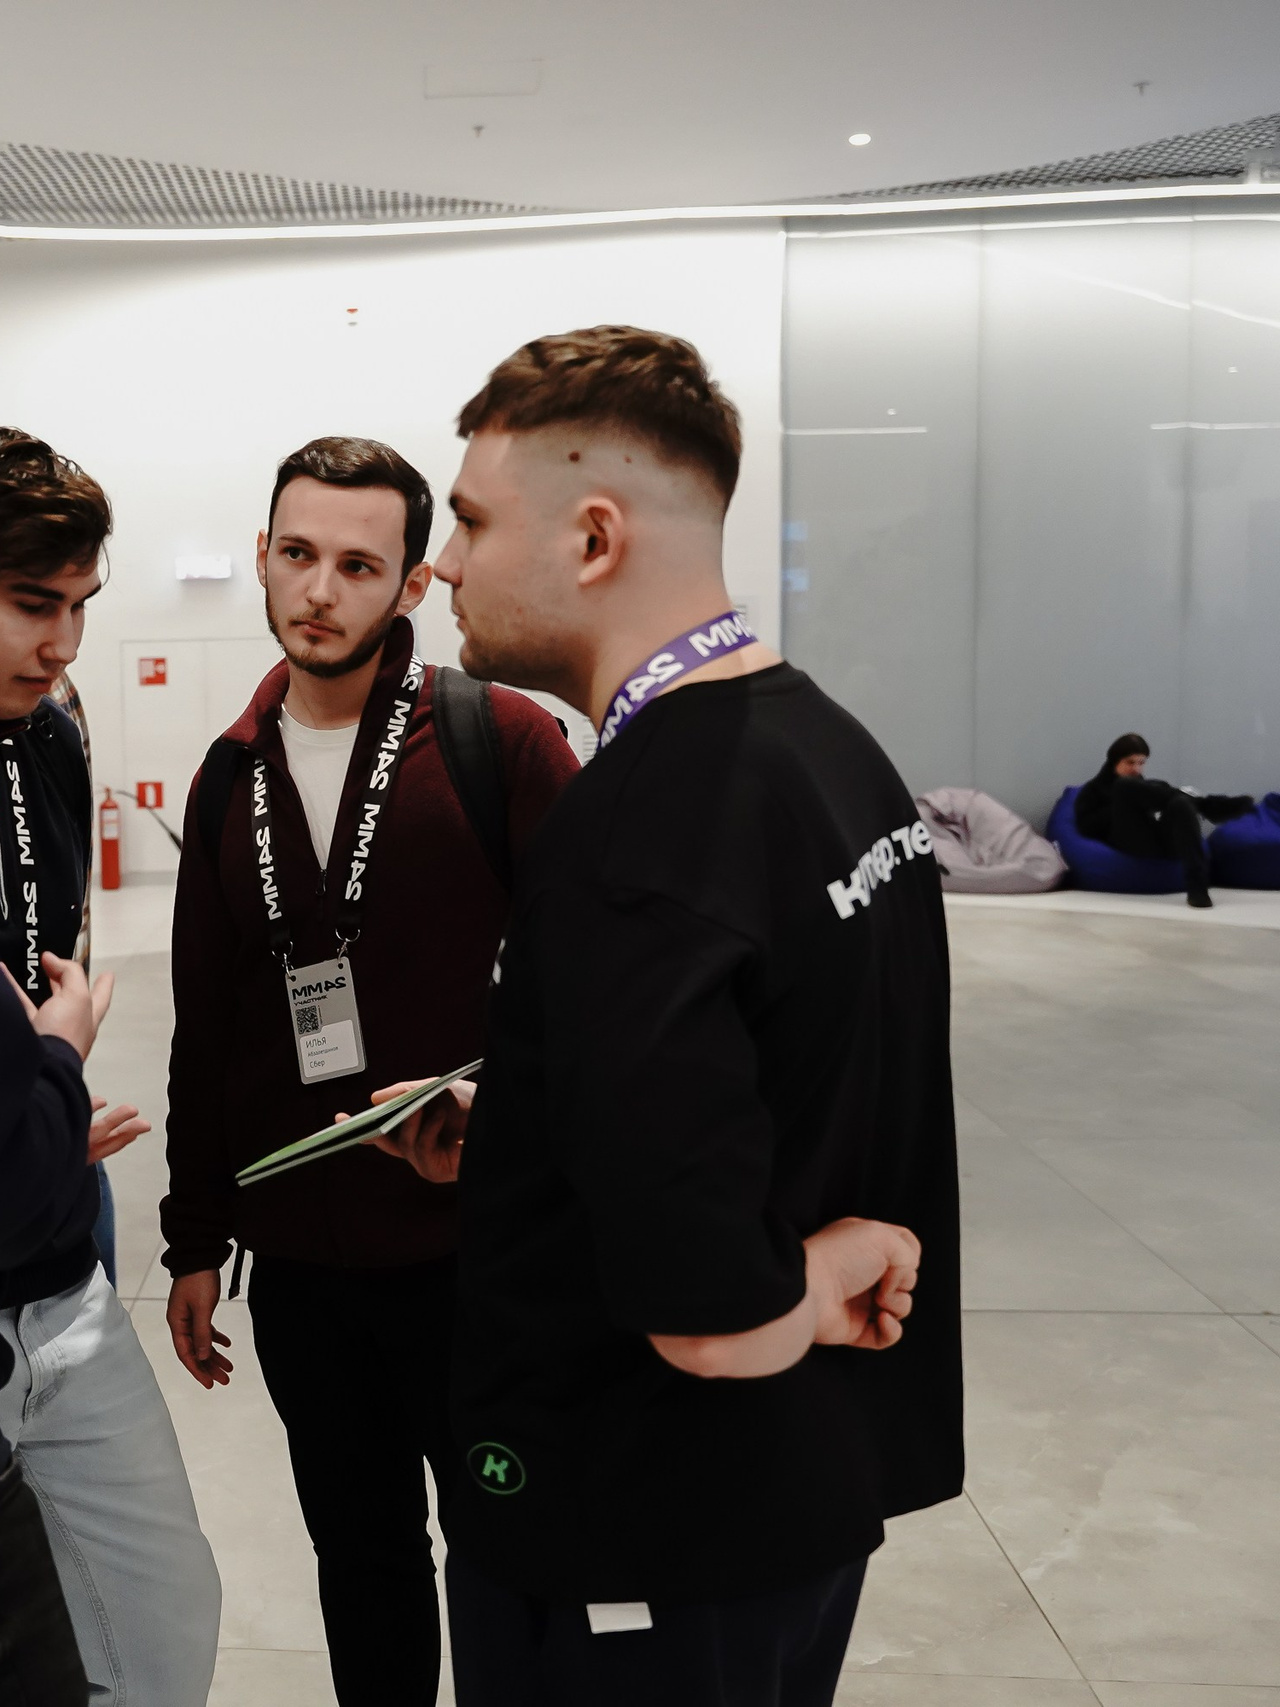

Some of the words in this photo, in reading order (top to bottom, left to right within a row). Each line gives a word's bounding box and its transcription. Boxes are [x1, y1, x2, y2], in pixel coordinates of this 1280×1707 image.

[370, 699, 411, 790] MMAS
[600, 652, 685, 748] MAS
[6, 759, 34, 865] MMAS
[345, 803, 380, 901] MMAS
[256, 826, 282, 920] MMAS
[23, 881, 39, 989] MMAS
[291, 976, 347, 1000] MMAS
